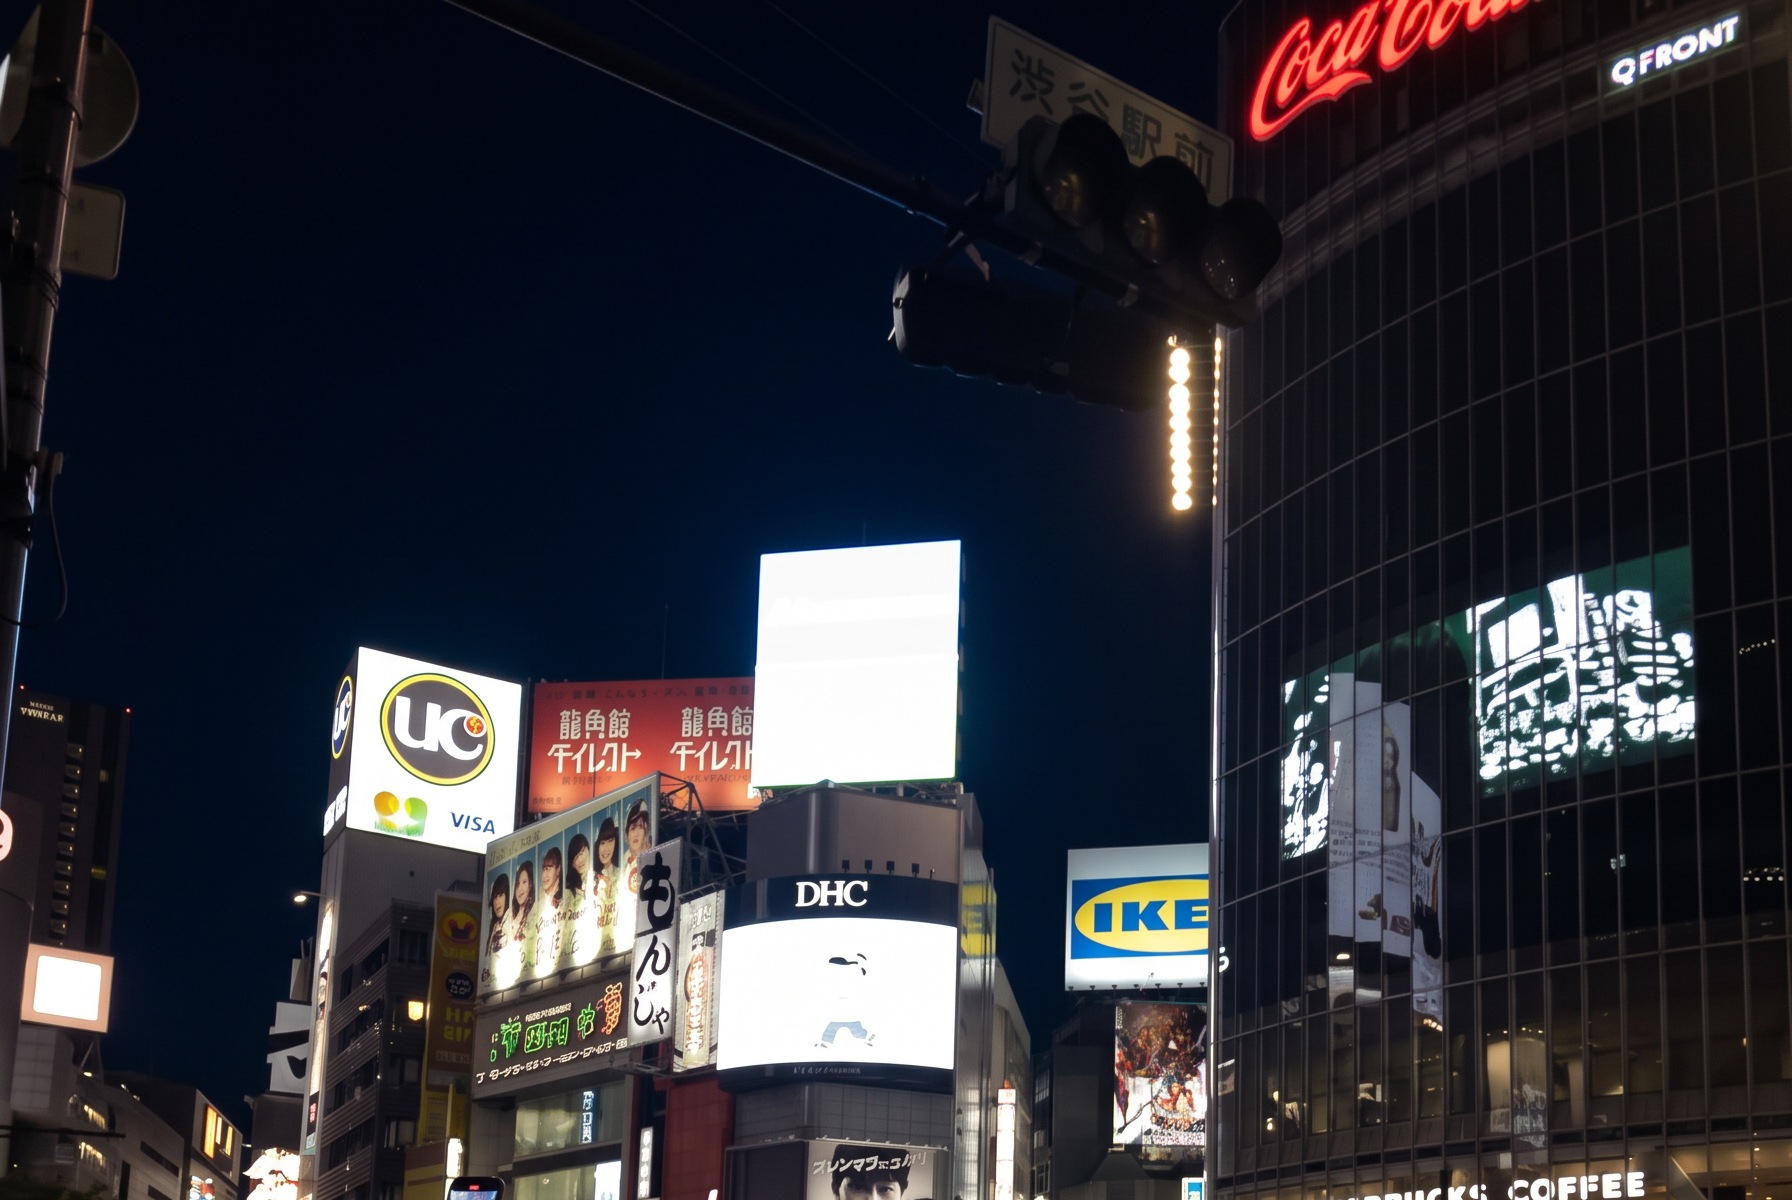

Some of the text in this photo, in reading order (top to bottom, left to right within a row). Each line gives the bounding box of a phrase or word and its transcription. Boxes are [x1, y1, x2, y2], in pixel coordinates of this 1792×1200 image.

[1611, 15, 1739, 86] QFRONT
[449, 811, 496, 835] VISA
[795, 880, 869, 907] DHC
[633, 851, 675, 1035] もんじゃ
